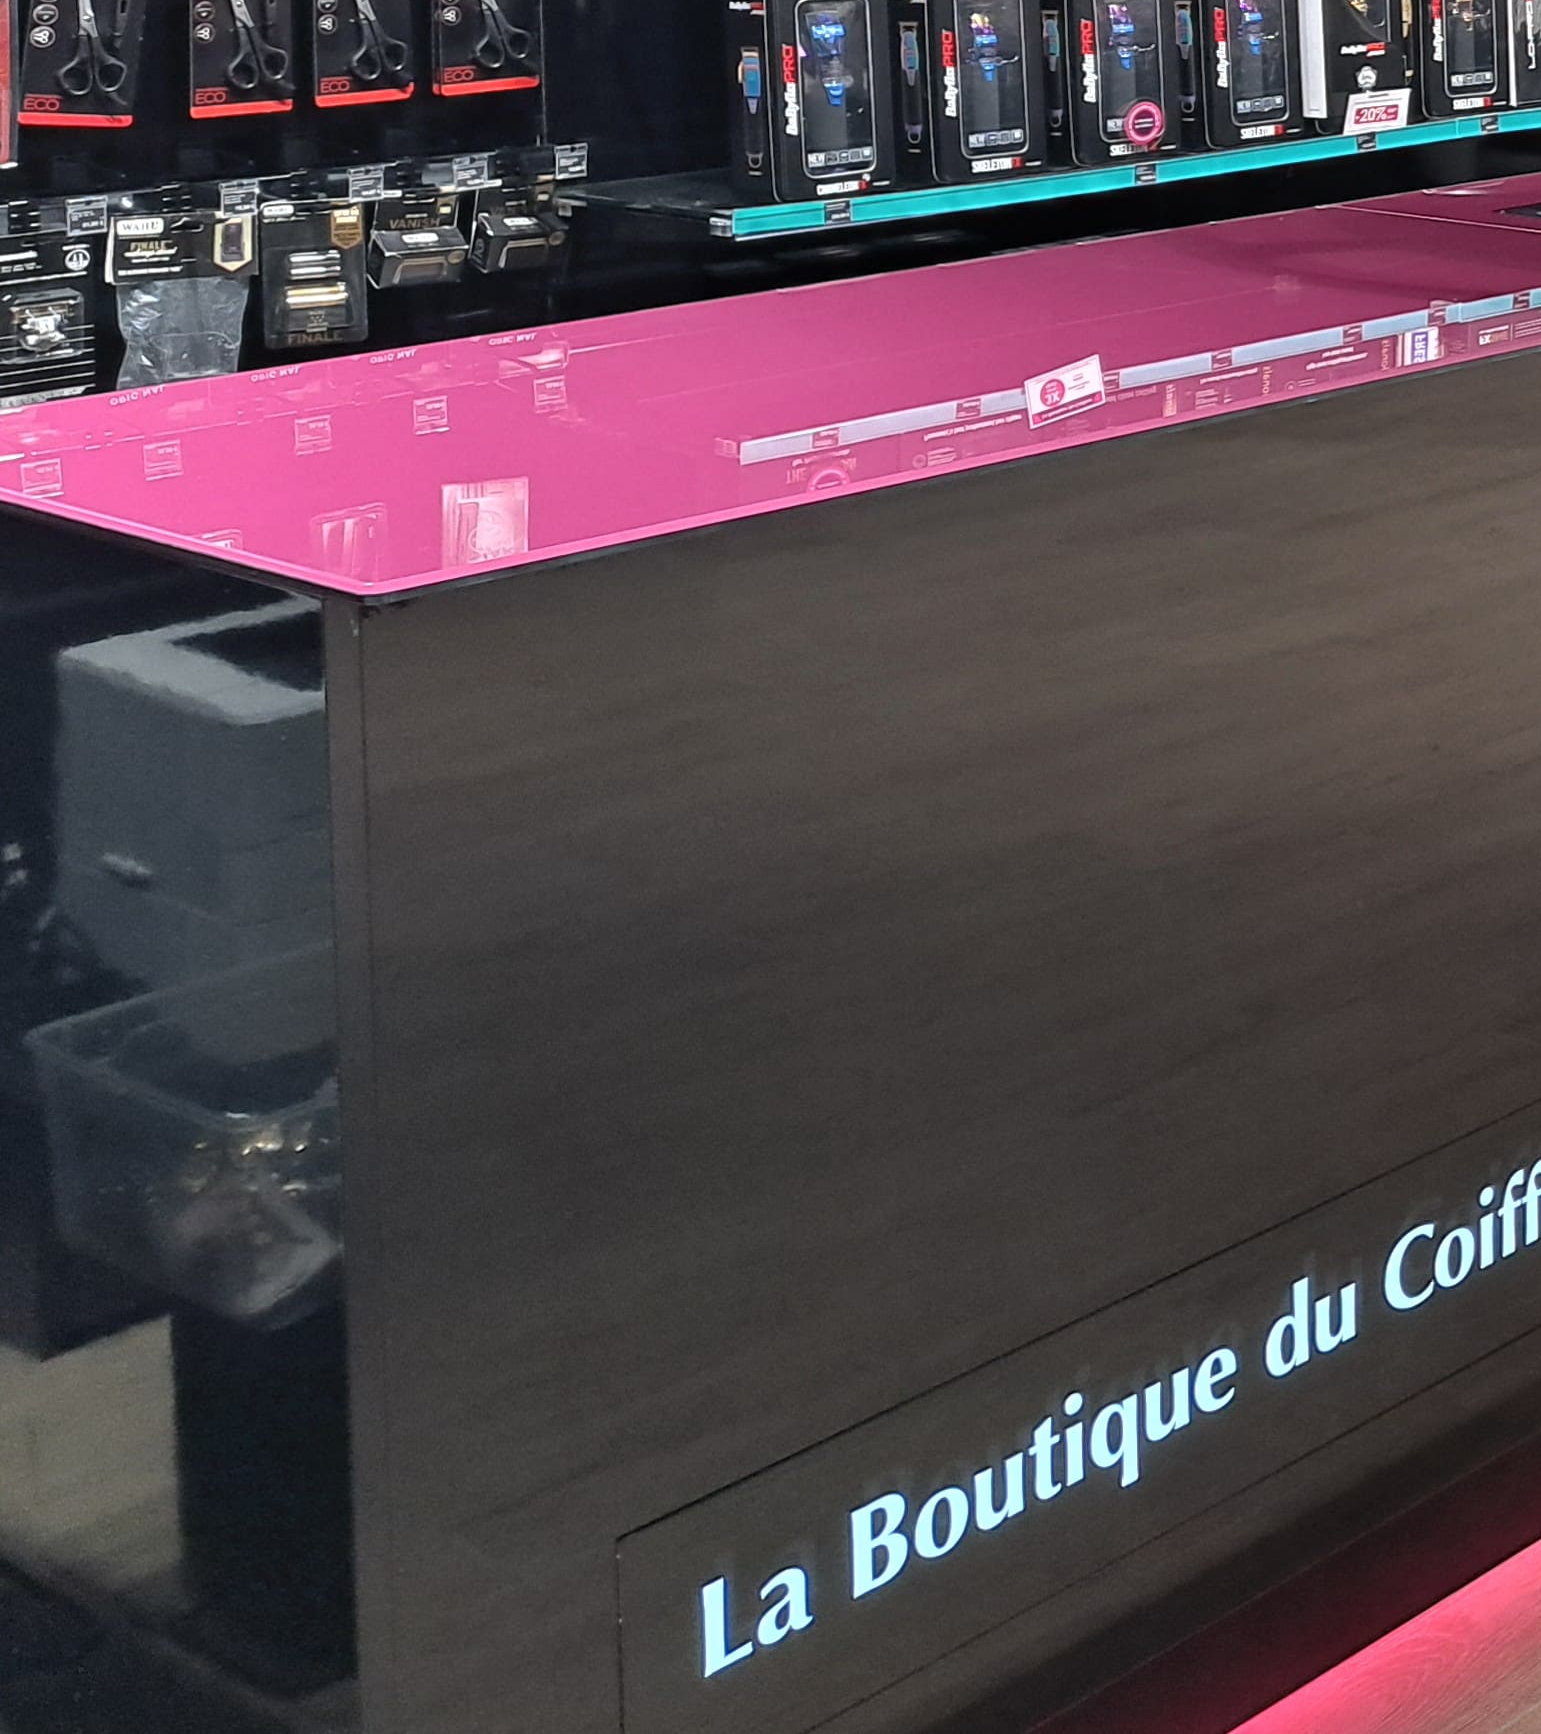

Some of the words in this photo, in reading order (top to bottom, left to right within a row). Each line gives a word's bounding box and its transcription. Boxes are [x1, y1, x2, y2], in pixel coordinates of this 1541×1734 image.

[444, 70, 475, 82] ECO
[320, 80, 350, 93] ECO
[195, 91, 227, 103] ECO
[24, 97, 60, 111] ECO
[1355, 106, 1388, 123] -20%
[121, 221, 159, 232] WAHL
[699, 1558, 812, 1681] La
[848, 1344, 1237, 1603] Boutique
[1264, 1276, 1357, 1380] du
